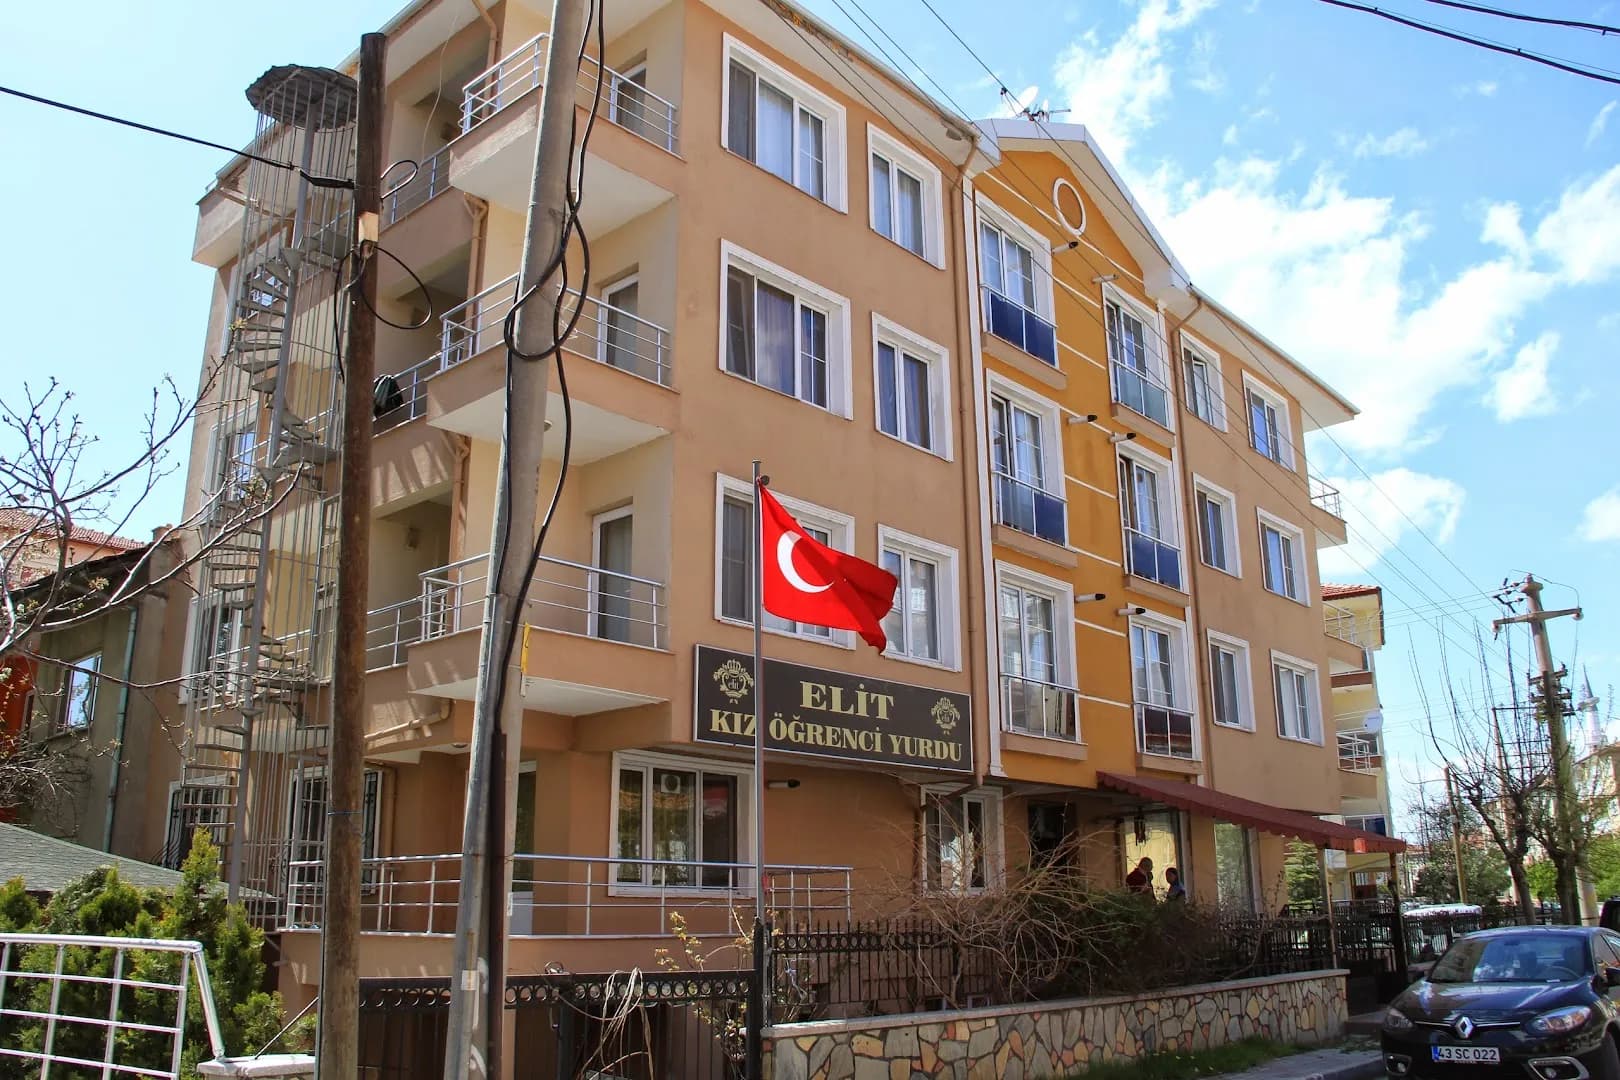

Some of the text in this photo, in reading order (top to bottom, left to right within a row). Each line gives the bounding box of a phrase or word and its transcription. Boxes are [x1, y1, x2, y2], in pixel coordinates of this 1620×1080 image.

[800, 681, 893, 720] ELİT
[709, 709, 962, 761] KIZ ÖĞRENCİ YURDU
[1438, 1048, 1497, 1060] 43 SC 022
